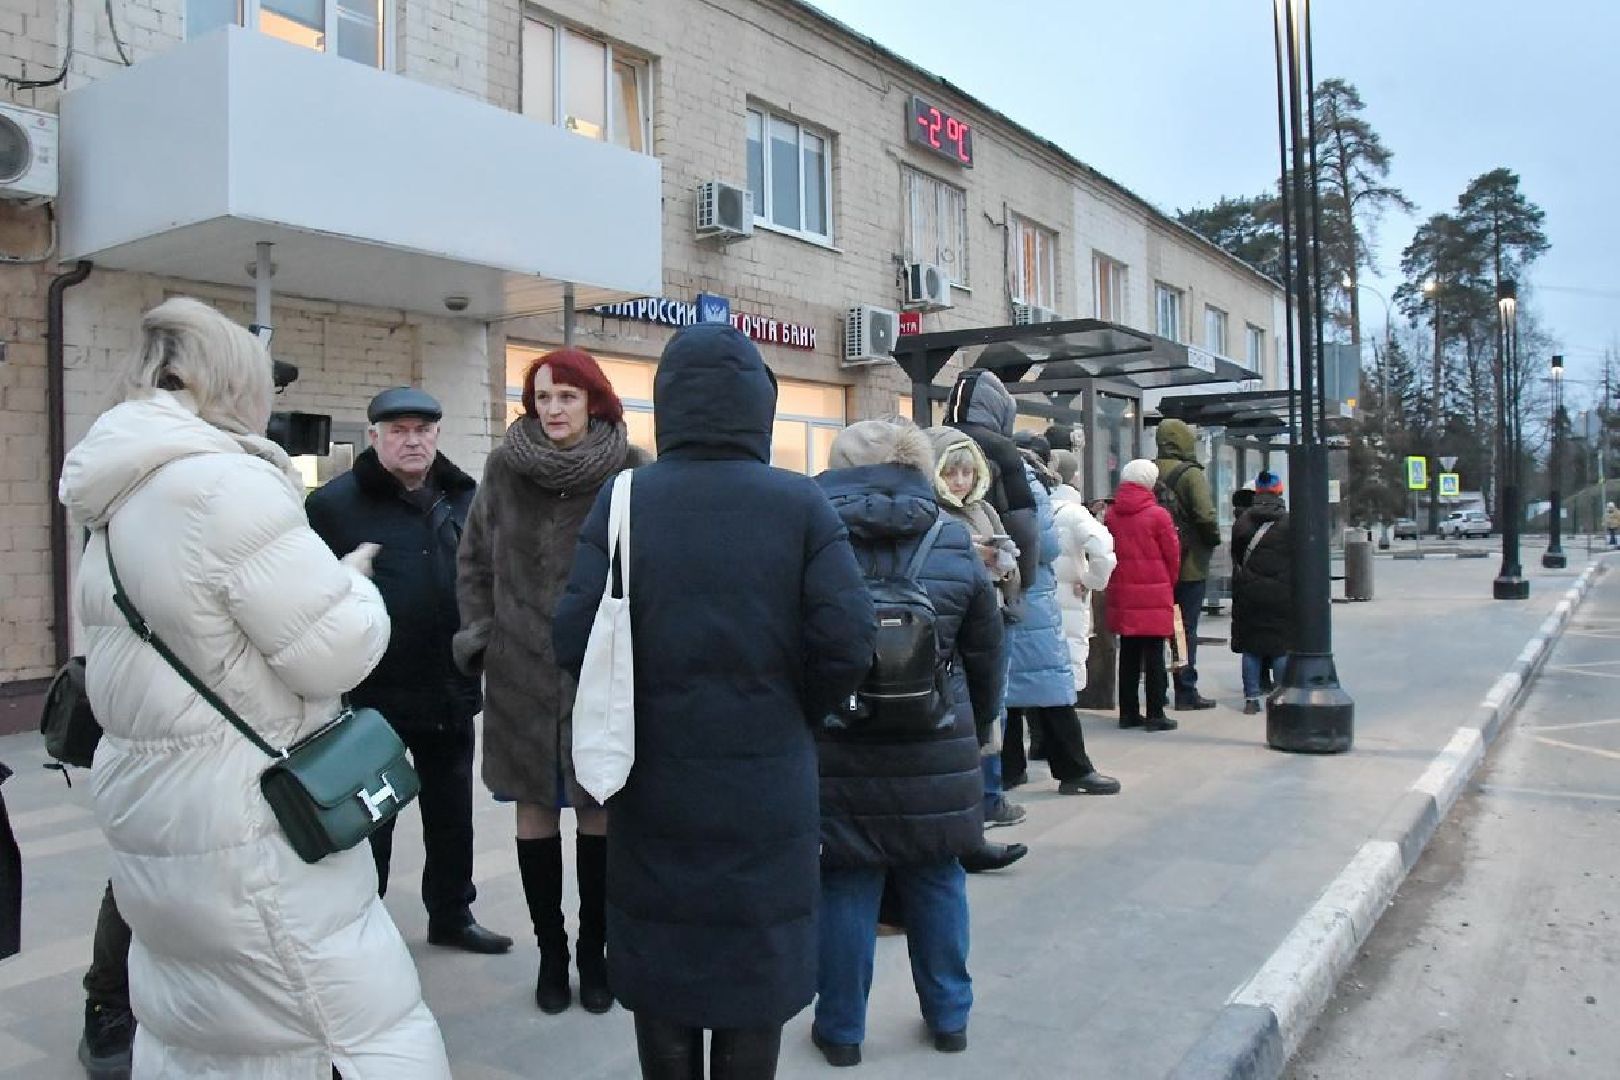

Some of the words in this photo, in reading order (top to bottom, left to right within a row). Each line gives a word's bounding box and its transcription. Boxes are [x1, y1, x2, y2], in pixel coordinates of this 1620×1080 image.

[638, 298, 697, 326] РОССИИ
[782, 323, 817, 349] БАНК
[900, 321, 917, 333] ЧТА
